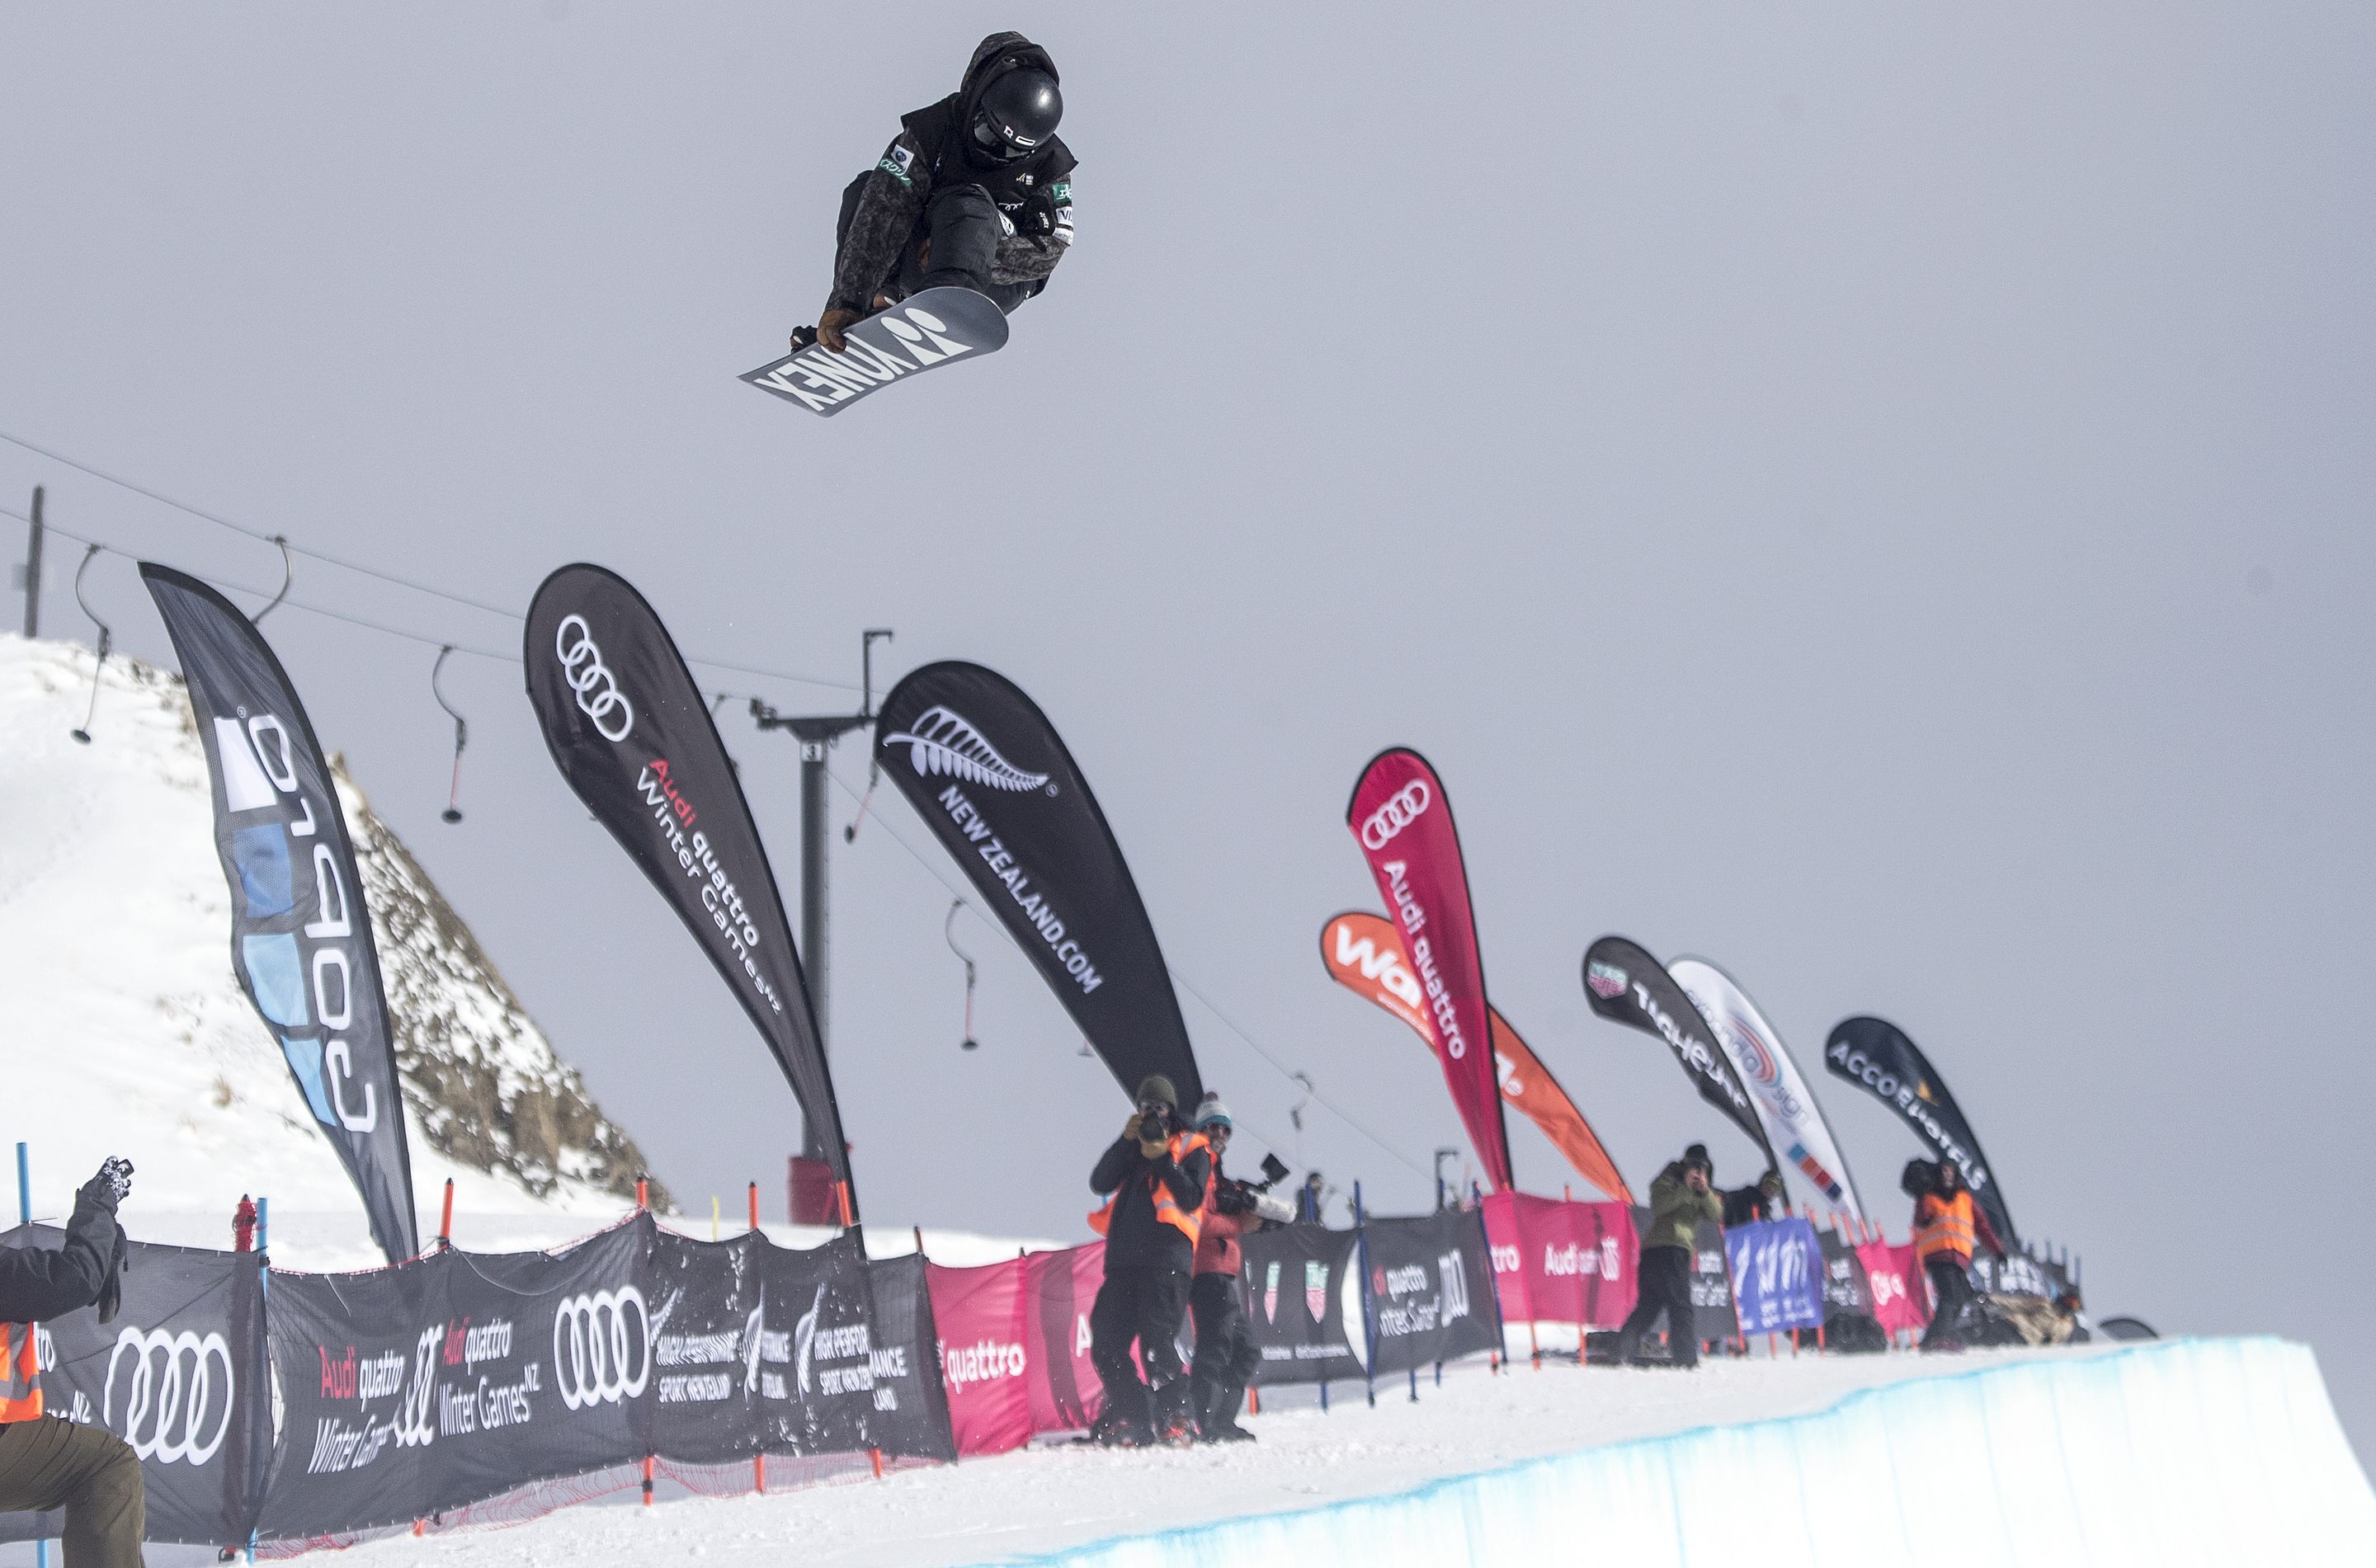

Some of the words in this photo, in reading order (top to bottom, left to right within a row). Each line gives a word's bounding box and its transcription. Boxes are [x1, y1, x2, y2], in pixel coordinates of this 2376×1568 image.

[752, 332, 920, 412] YONEX
[636, 766, 703, 879] Winter
[650, 756, 697, 827] Audi
[691, 830, 761, 948] quattro
[977, 838, 1104, 996] ZEALAND.COM
[1383, 859, 1426, 935] Audi
[1414, 935, 1466, 1060] quattro
[318, 1345, 356, 1399] Audi
[359, 1349, 405, 1412] quattro
[464, 1318, 512, 1376] quattro
[947, 1338, 1025, 1395] quattro
[307, 1417, 361, 1474] Winter
[439, 1384, 475, 1437] Winter
